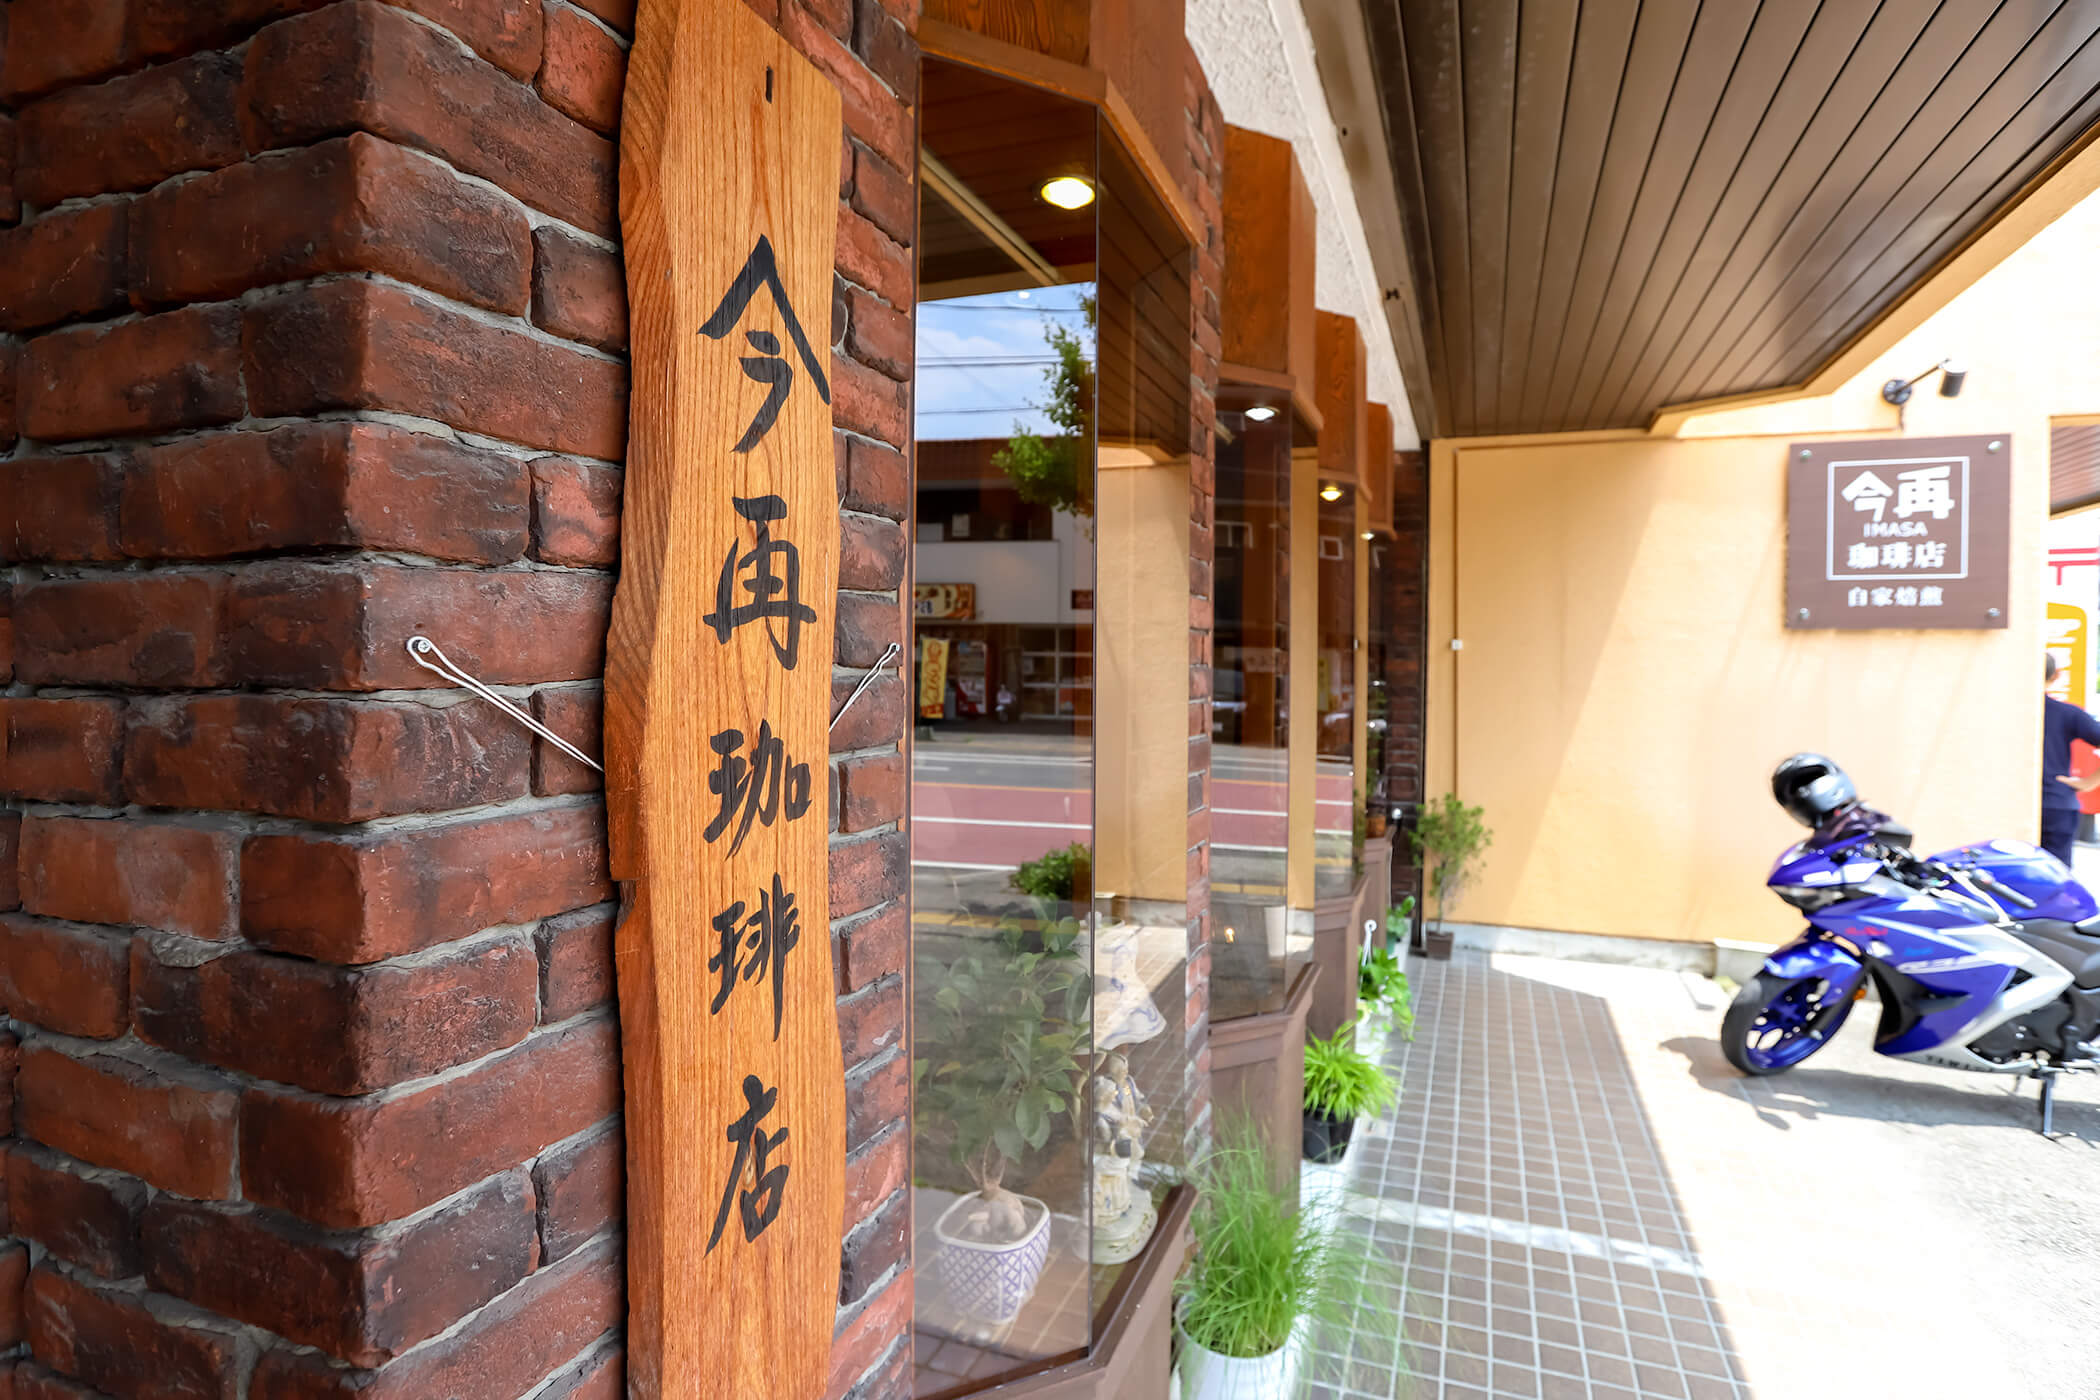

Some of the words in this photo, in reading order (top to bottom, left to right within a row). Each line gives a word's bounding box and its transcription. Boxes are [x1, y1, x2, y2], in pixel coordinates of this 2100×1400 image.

[1841, 465, 1955, 522] 今再
[1863, 521, 1928, 537] IMASA
[1847, 541, 1947, 569] 珈琲店
[697, 233, 832, 1258] 今再珈琲店
